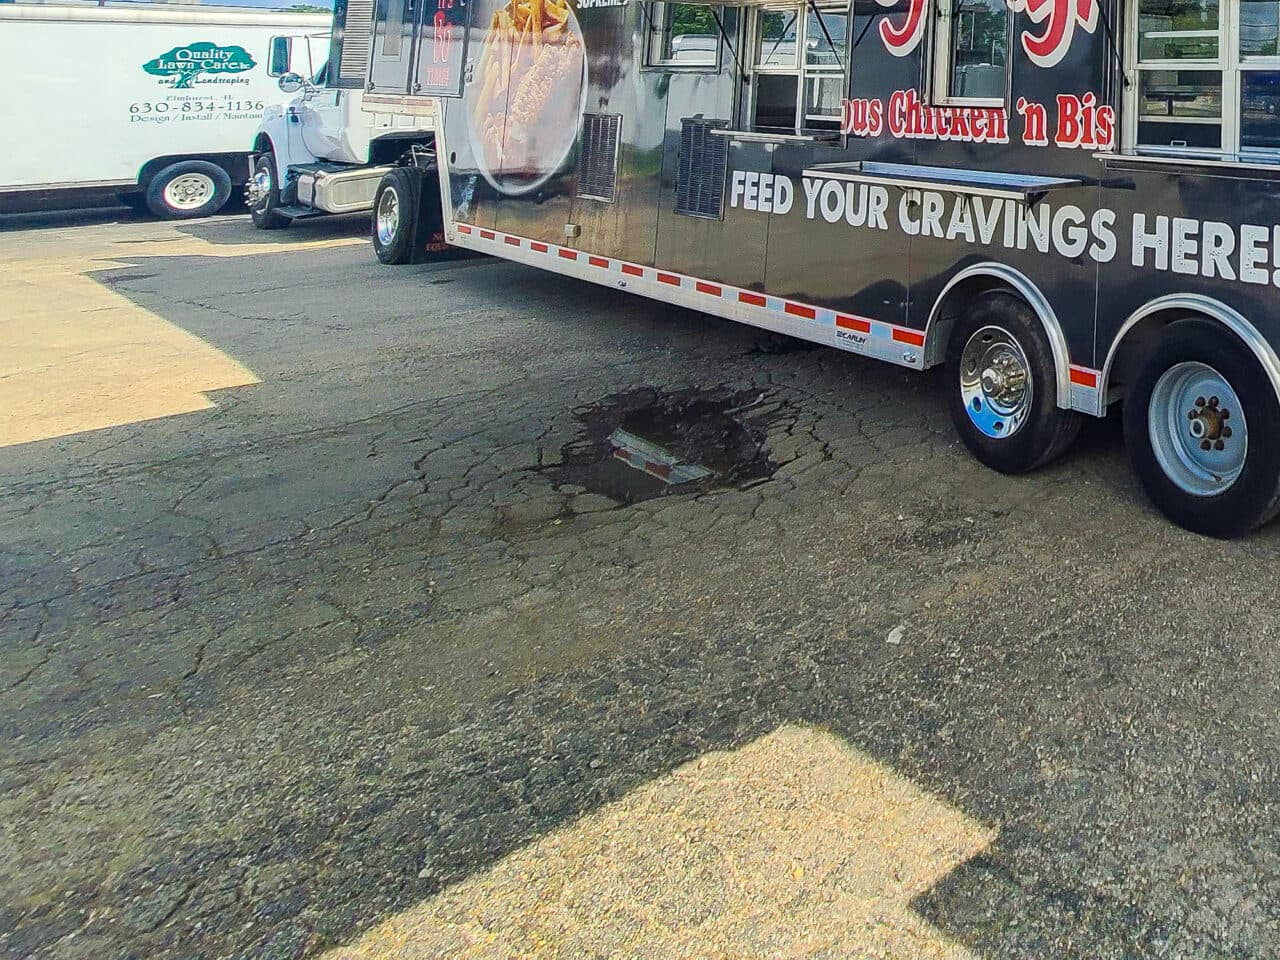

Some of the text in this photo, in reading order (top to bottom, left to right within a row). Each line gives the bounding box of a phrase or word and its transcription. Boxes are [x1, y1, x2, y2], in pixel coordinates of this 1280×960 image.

[175, 48, 234, 62] Quality
[157, 59, 196, 70] Lawn
[200, 59, 240, 70] Care
[158, 76, 250, 86] and Landscaping
[129, 100, 264, 114] 630-834-1136
[130, 114, 170, 124] Design
[181, 112, 213, 121] Install
[888, 88, 1009, 145] Chicken
[1017, 96, 1049, 147] 'n
[730, 169, 795, 215] FEED
[802, 177, 889, 231] YOUR
[899, 188, 1118, 263] CRAVINGS
